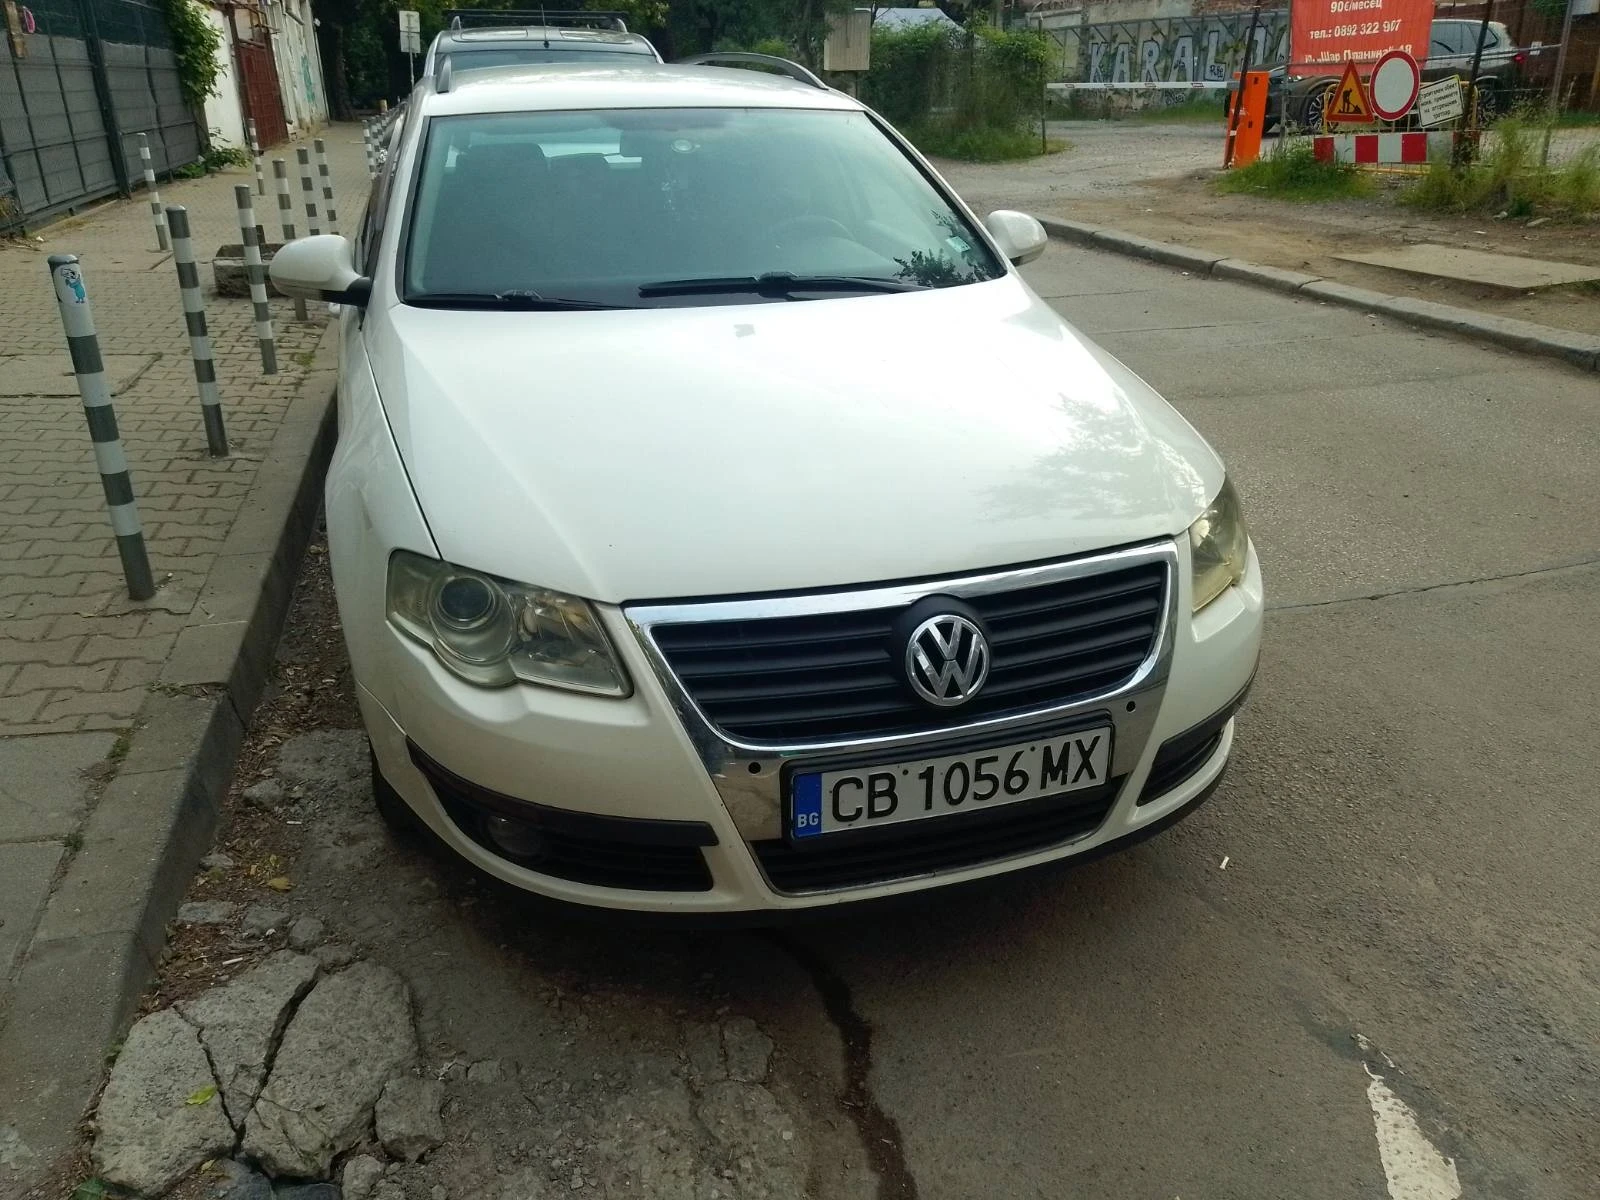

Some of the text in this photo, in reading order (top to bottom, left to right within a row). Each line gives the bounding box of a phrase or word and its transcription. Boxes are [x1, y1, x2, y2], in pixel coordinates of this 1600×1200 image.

[1334, 23, 1357, 38] 0892
[1359, 21, 1379, 35] 322
[831, 735, 1101, 823] CB 1056 MX
[796, 812, 819, 829] BG
